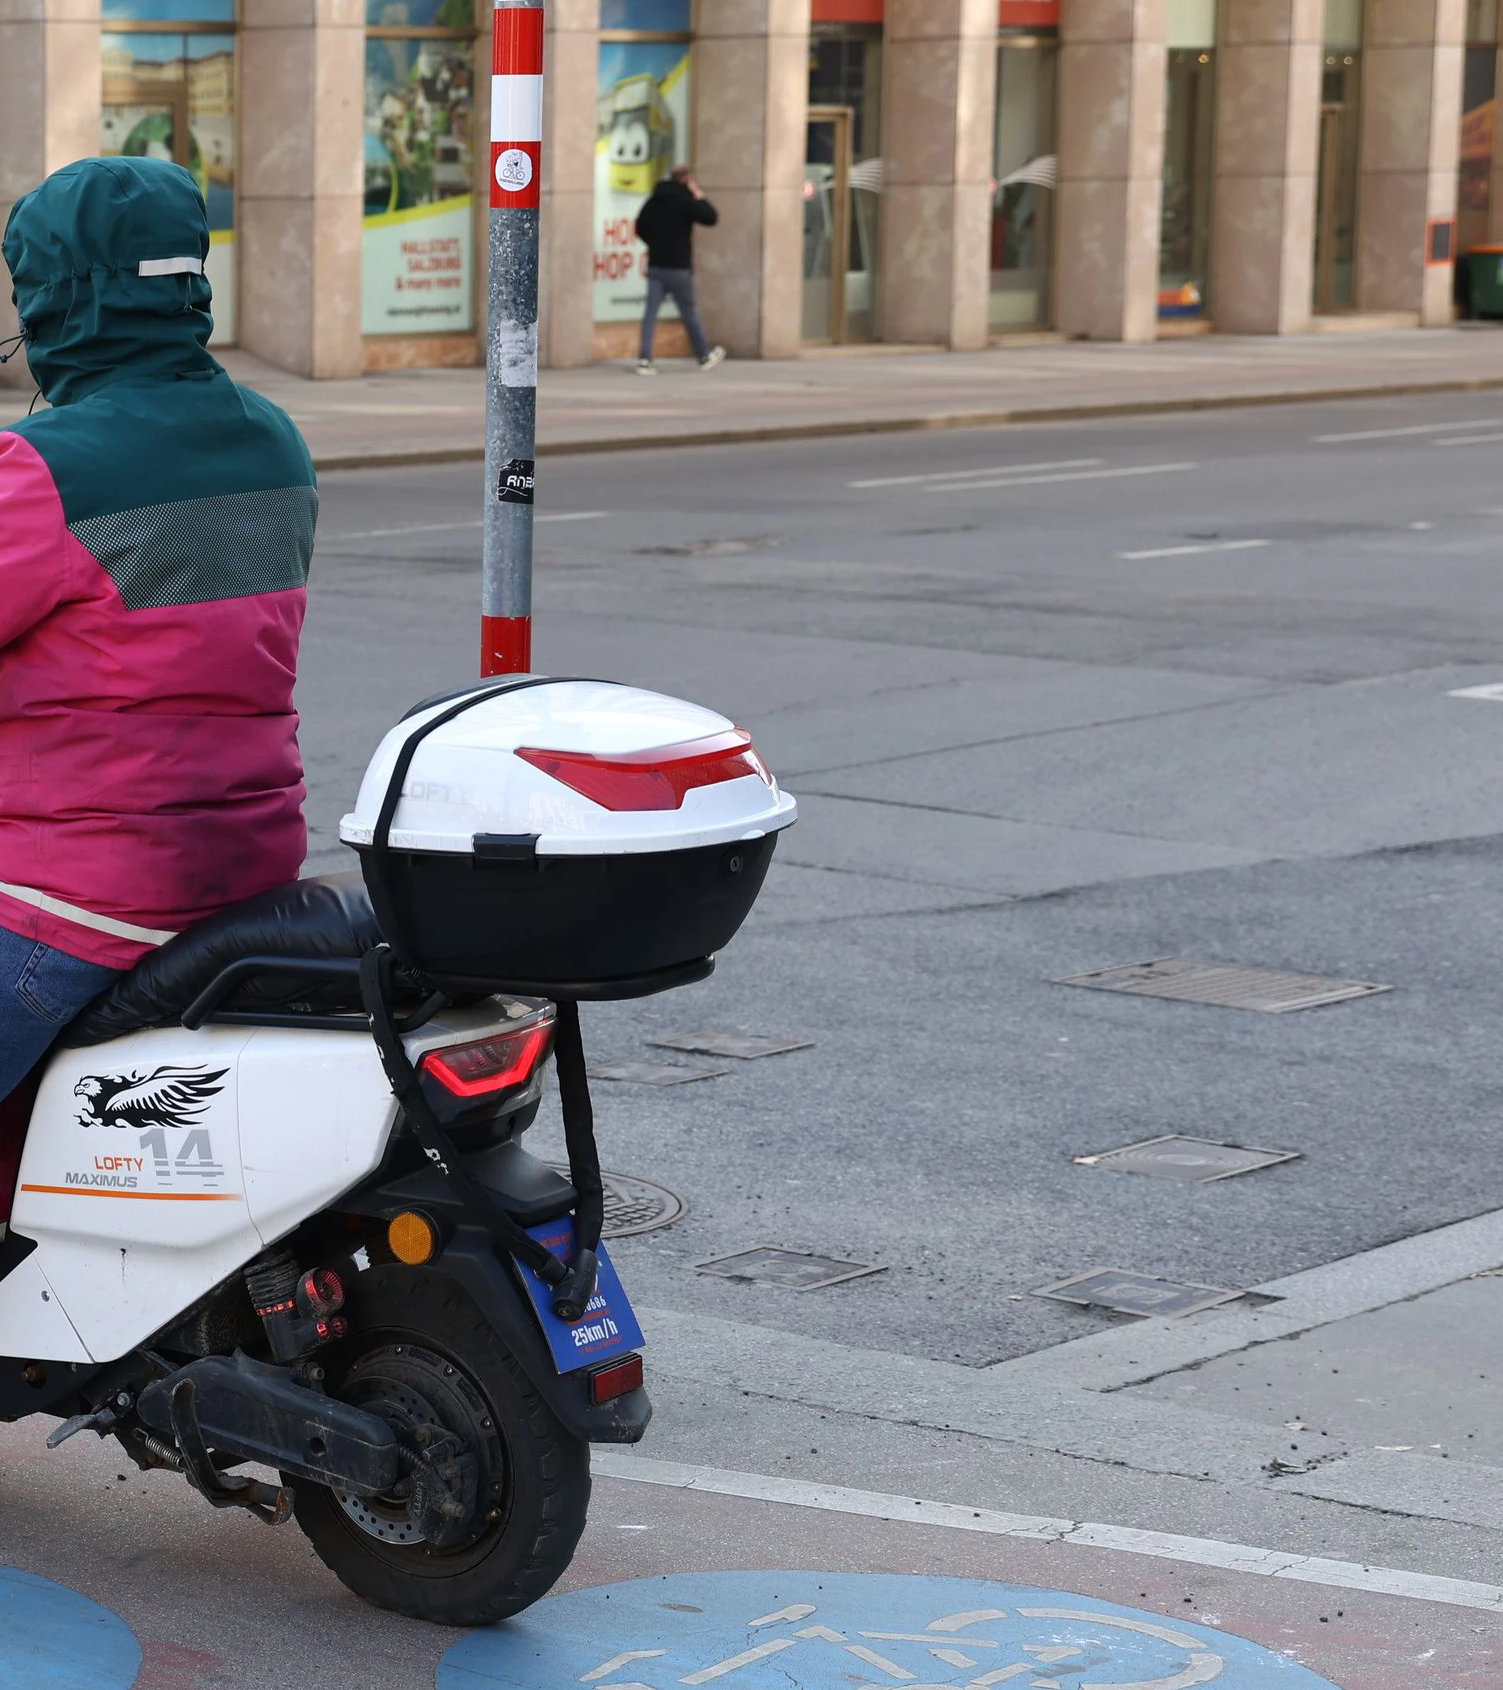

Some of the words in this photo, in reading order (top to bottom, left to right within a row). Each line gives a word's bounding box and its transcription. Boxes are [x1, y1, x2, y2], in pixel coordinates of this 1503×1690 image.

[593, 252, 633, 280] HOP
[94, 1155, 144, 1172] LOFTY
[139, 1128, 225, 1187] 14
[65, 1172, 138, 1189] MAXIMUS
[571, 1317, 619, 1347] 25km/h
